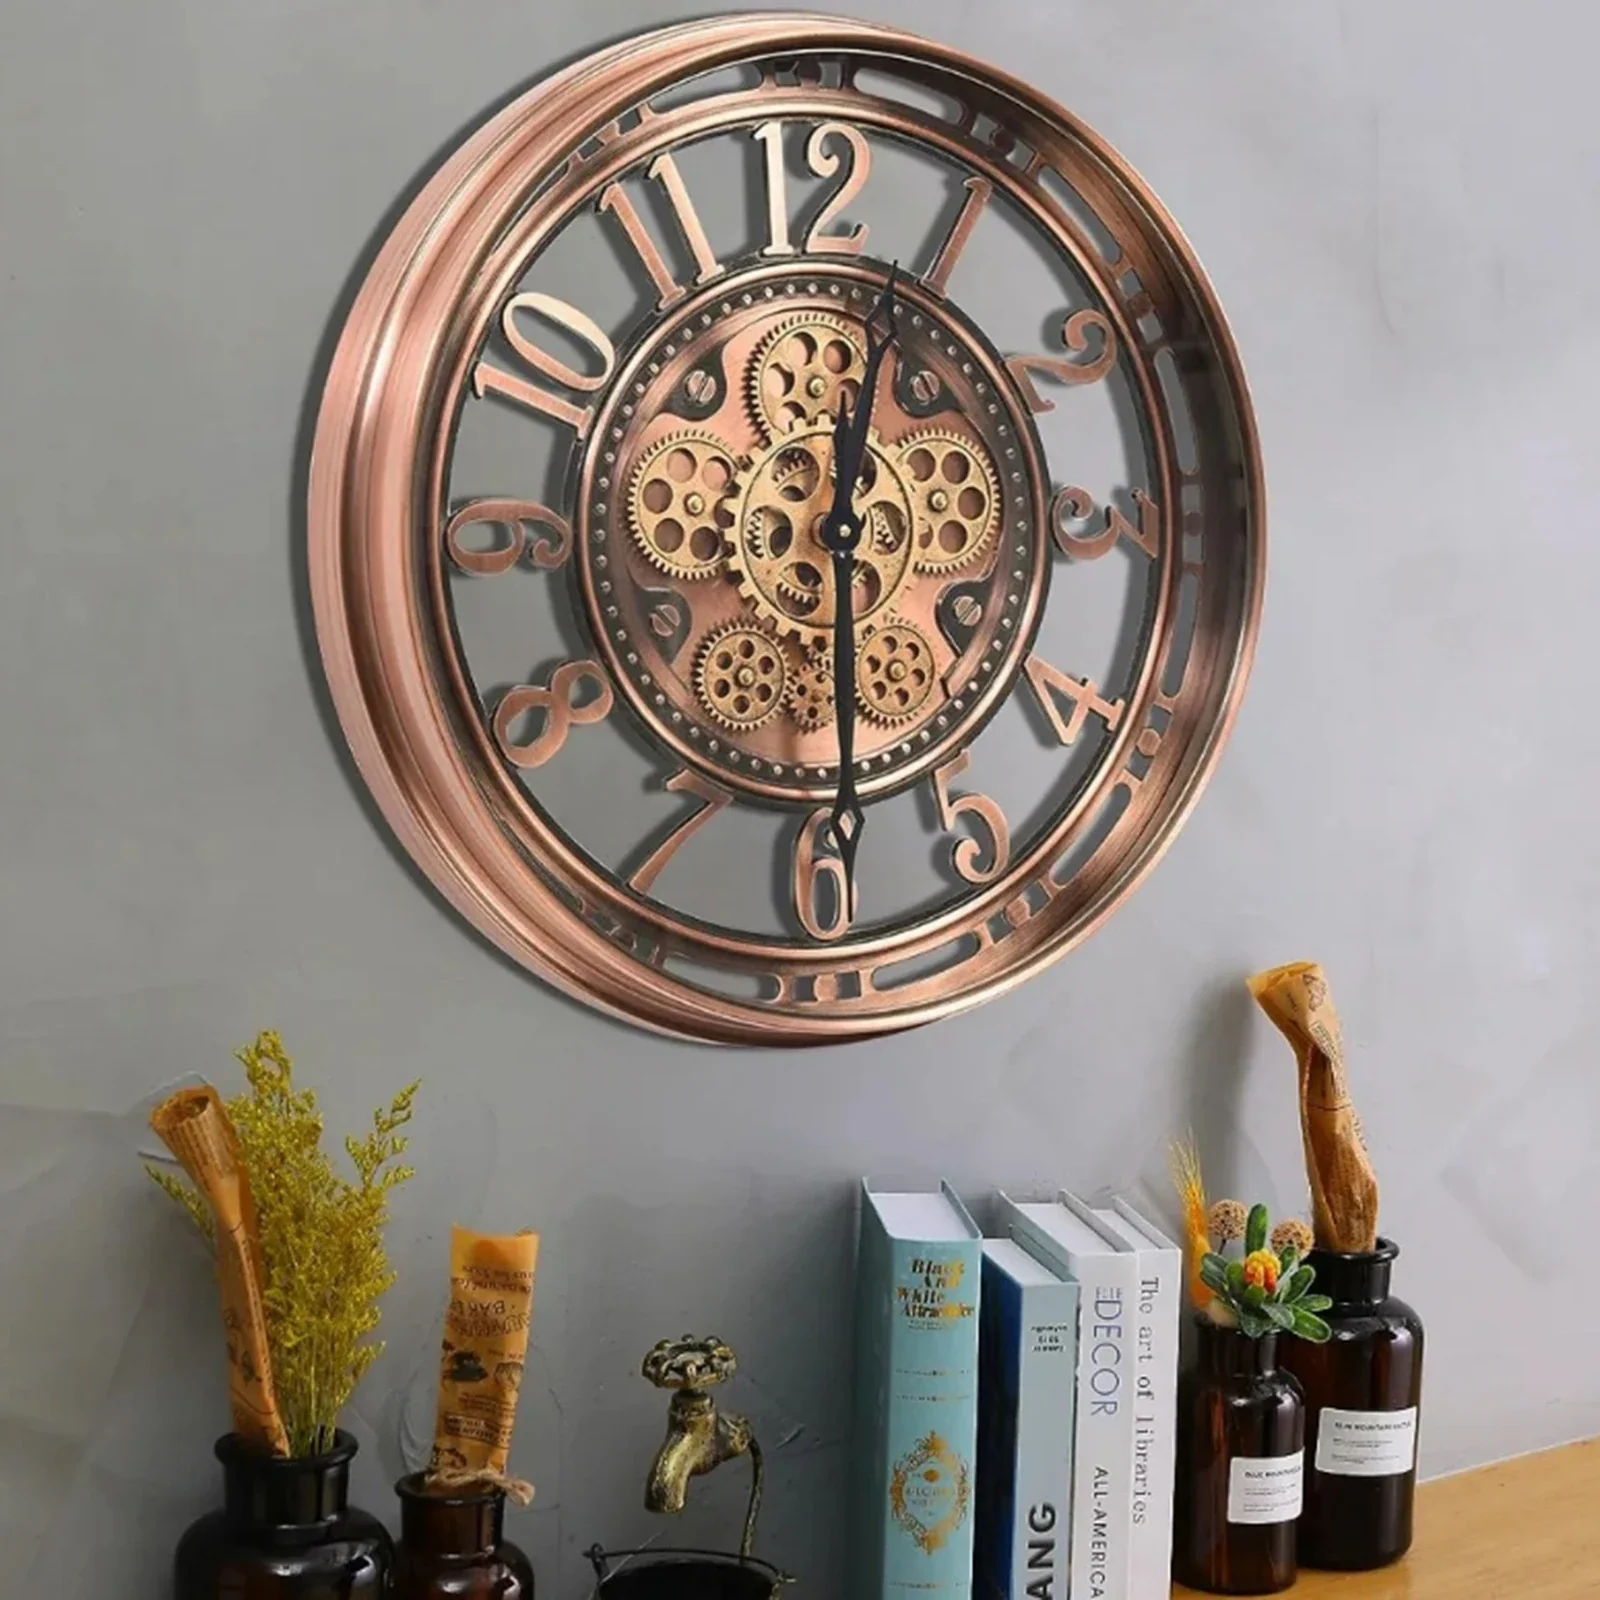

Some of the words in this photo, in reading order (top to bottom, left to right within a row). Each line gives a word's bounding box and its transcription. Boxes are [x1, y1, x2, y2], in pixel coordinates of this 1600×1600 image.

[598, 152, 724, 310] 11
[753, 121, 873, 257] 12
[919, 176, 991, 298] 1
[472, 291, 616, 440] 10
[1004, 308, 1120, 414] 2
[445, 496, 570, 577] 9
[1052, 484, 1161, 562] 3
[492, 659, 614, 769] 8
[1023, 654, 1126, 746] 4
[627, 770, 735, 895] 7
[931, 751, 1012, 885] 5
[793, 807, 859, 941] 6
[896, 1285, 945, 1304] White
[1138, 1277, 1159, 1314] The
[1138, 1326, 1153, 1363] art
[1090, 1299, 1122, 1416] DECOR
[1136, 1376, 1154, 1400] of
[1132, 1414, 1156, 1524] libraries
[1090, 1466, 1109, 1599] ALL-AMERICA
